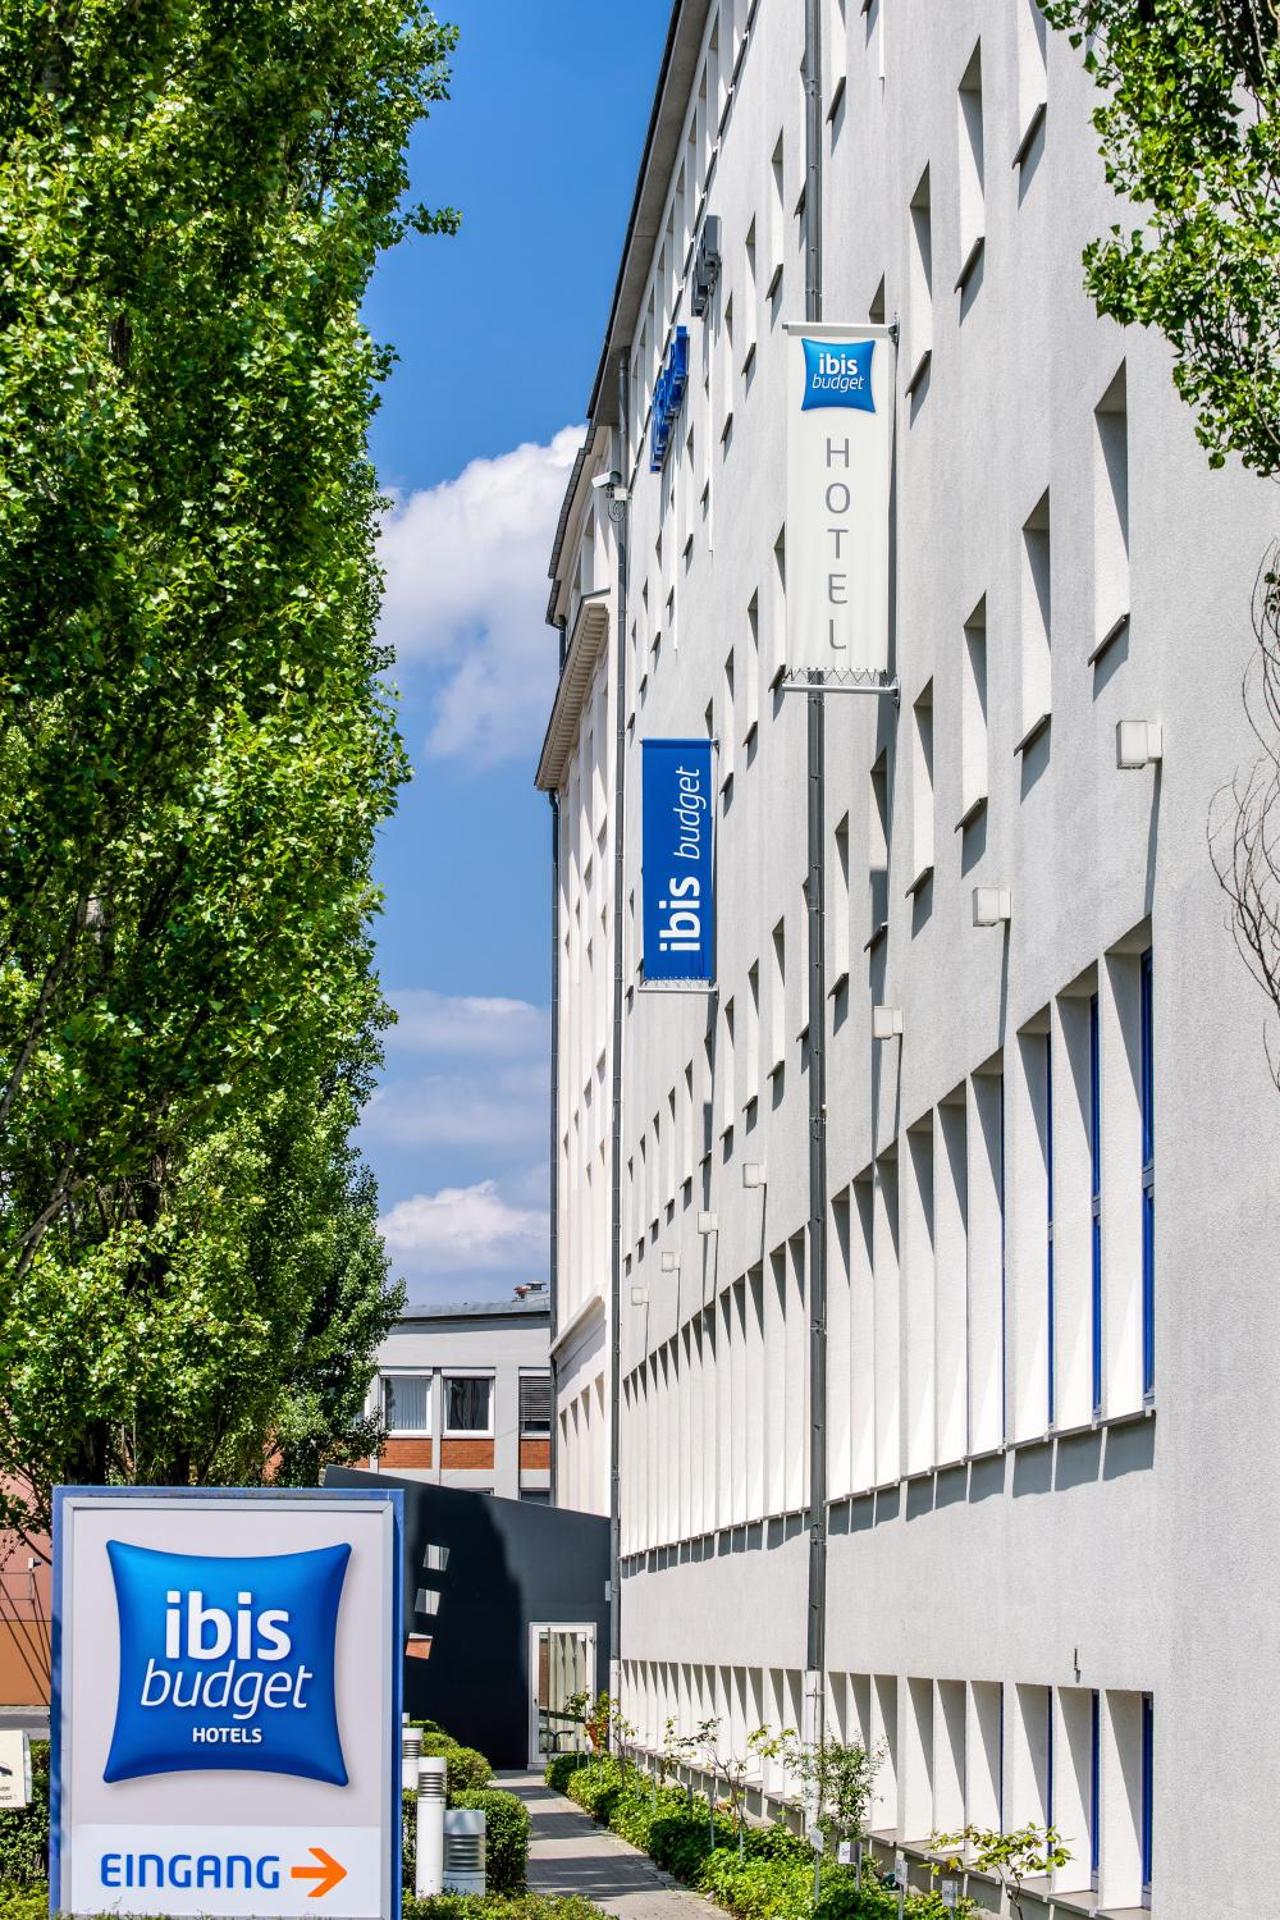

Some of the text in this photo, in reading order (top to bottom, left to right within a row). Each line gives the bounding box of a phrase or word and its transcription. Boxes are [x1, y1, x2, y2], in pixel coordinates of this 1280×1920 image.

[812, 374, 864, 393] budget
[818, 352, 858, 375] ibis
[825, 437, 851, 650] HOTEL
[659, 765, 707, 952] ibis budget
[165, 1590, 292, 1661] ibis
[140, 1658, 313, 1720] budget
[192, 1727, 262, 1743] HOTELS
[100, 1853, 280, 1889] EINGANG
